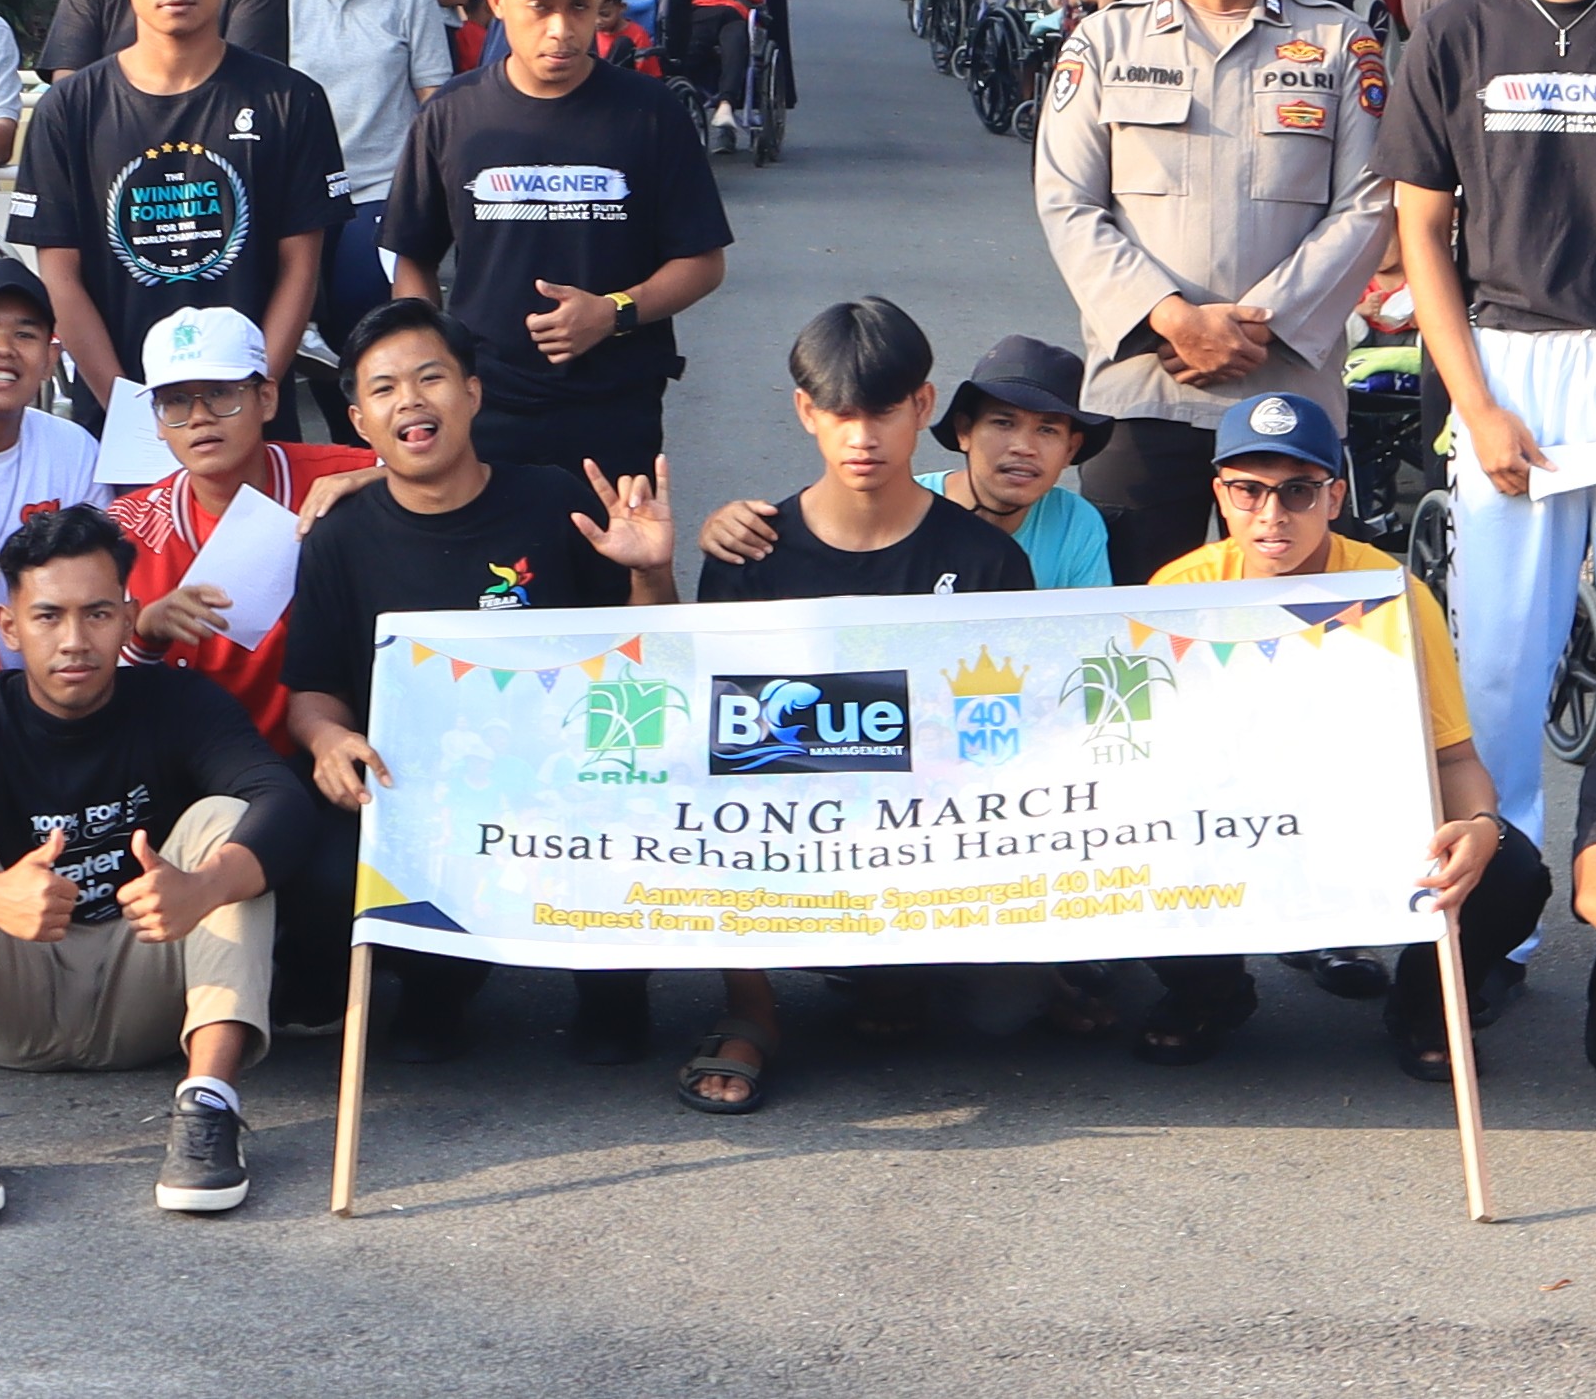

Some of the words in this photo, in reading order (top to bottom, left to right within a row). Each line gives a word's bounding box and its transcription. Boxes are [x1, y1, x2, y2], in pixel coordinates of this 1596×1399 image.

[1264, 71, 1333, 89] POLRI
[131, 181, 218, 204] WINNING
[510, 175, 608, 192] WAGNER
[130, 199, 221, 222] FORMULA
[548, 203, 590, 211] HEAVY
[592, 203, 624, 212] DUTY
[548, 212, 590, 220] BRAKE
[592, 212, 627, 220] FLUID
[132, 234, 167, 245] WORLD
[969, 701, 1007, 727] 40
[809, 745, 905, 757] MANAGEMENT
[958, 728, 1020, 759] MM
[1092, 741, 1152, 766] HJN
[578, 770, 668, 785] PRHJ
[30, 813, 79, 832] 100%
[85, 802, 122, 823] FOR
[674, 800, 846, 834] LONG
[875, 782, 1100, 831] MARCH
[476, 823, 613, 861] Pusat
[631, 834, 934, 873] Rehabilitasi
[954, 818, 1177, 862] Harapan
[1192, 809, 1303, 849] Jaya
[624, 881, 878, 912] Aanvraagformulier
[882, 874, 1047, 910] Sponsorgeld
[1052, 871, 1088, 894] 40
[1094, 864, 1151, 891] MM
[533, 903, 644, 930] Request
[649, 909, 714, 932] form
[720, 909, 886, 936] Sponsorship
[890, 910, 927, 932] 40
[933, 905, 989, 930] MM
[995, 901, 1046, 925] and
[1051, 890, 1144, 920] 40MM
[1149, 881, 1247, 911] WWW
